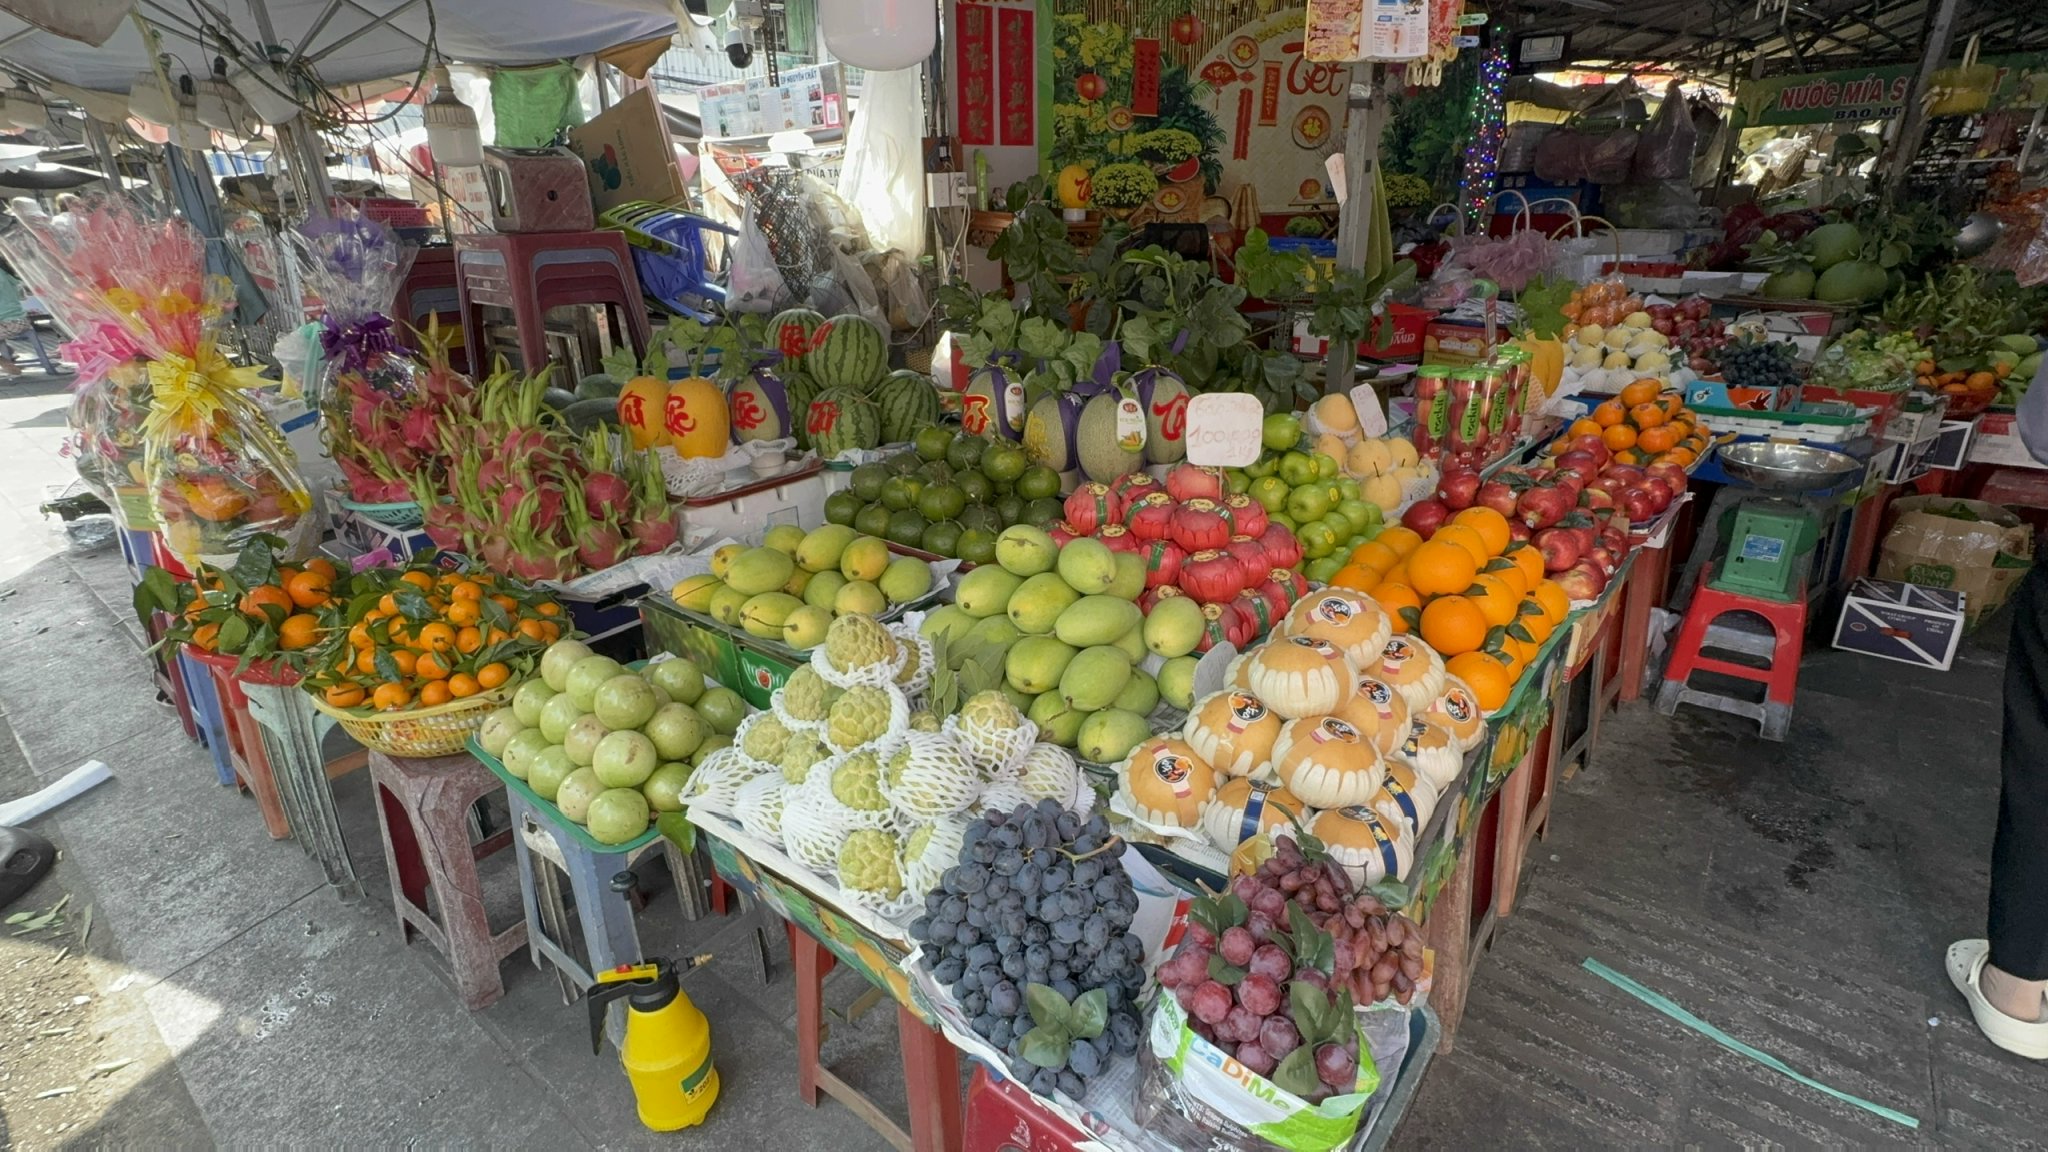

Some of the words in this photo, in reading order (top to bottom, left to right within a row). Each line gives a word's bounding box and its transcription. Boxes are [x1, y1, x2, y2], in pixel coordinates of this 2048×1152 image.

[1777, 78, 1839, 111] NƯỚC
[1841, 73, 1884, 106] MÍA
[1888, 76, 1910, 103] S
[1433, 398, 1444, 433] rockit
[1466, 401, 1478, 437] rockit
[1190, 1035, 1291, 1111] CaDiMe
